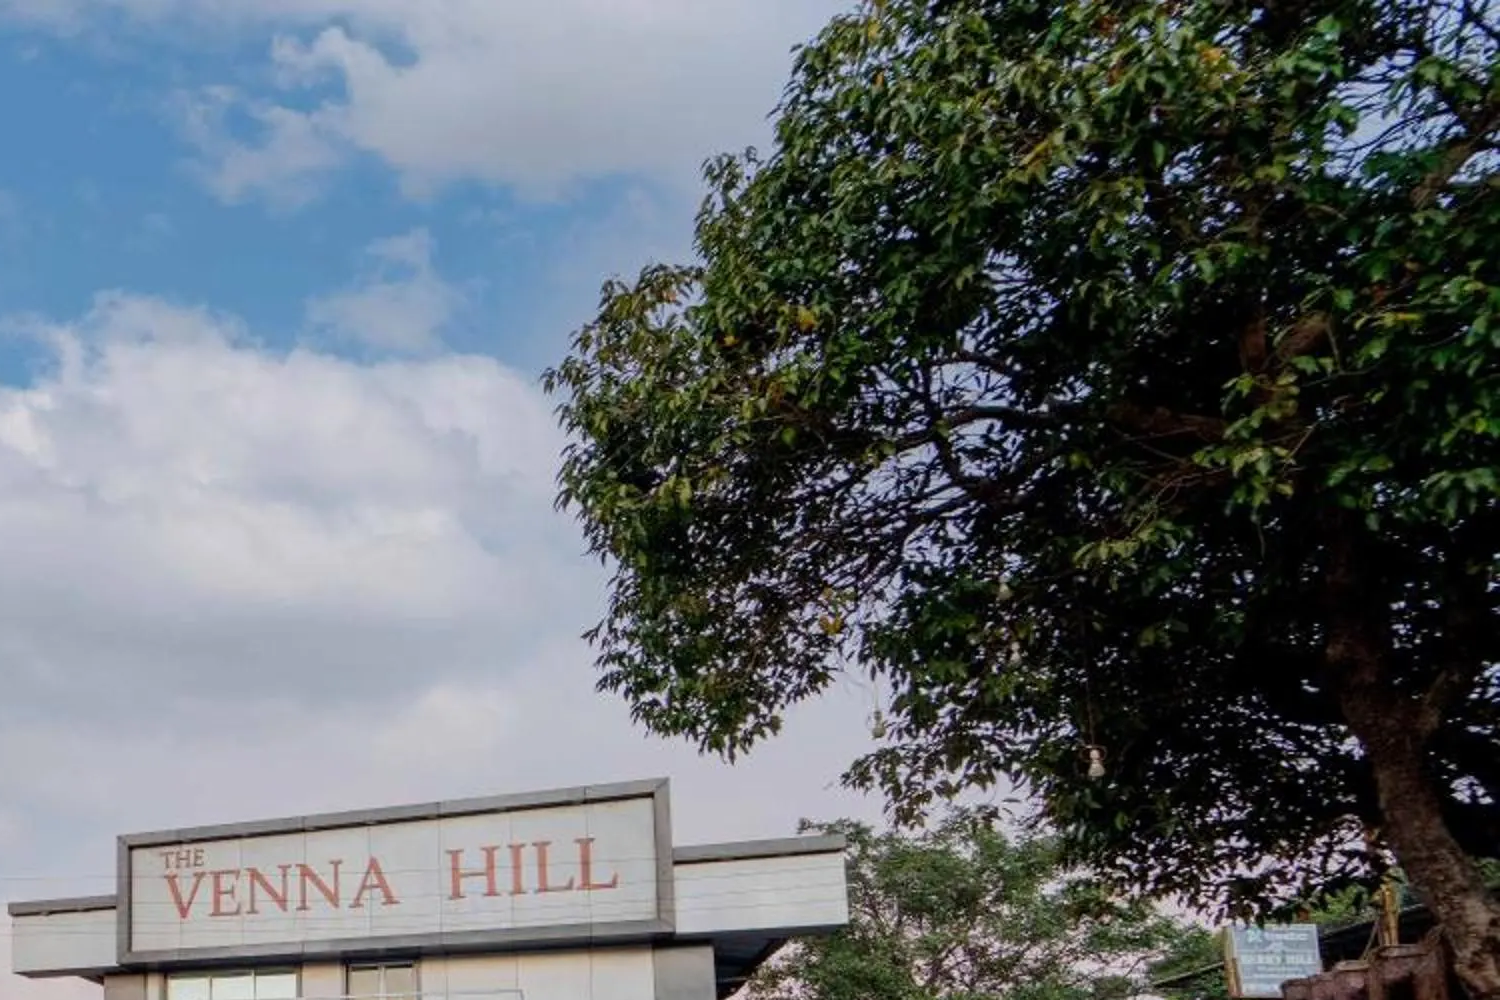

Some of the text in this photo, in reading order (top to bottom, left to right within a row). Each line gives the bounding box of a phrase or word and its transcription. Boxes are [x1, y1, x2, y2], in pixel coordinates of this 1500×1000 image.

[160, 849, 204, 869] THE
[164, 837, 618, 918] VENNA HILL
